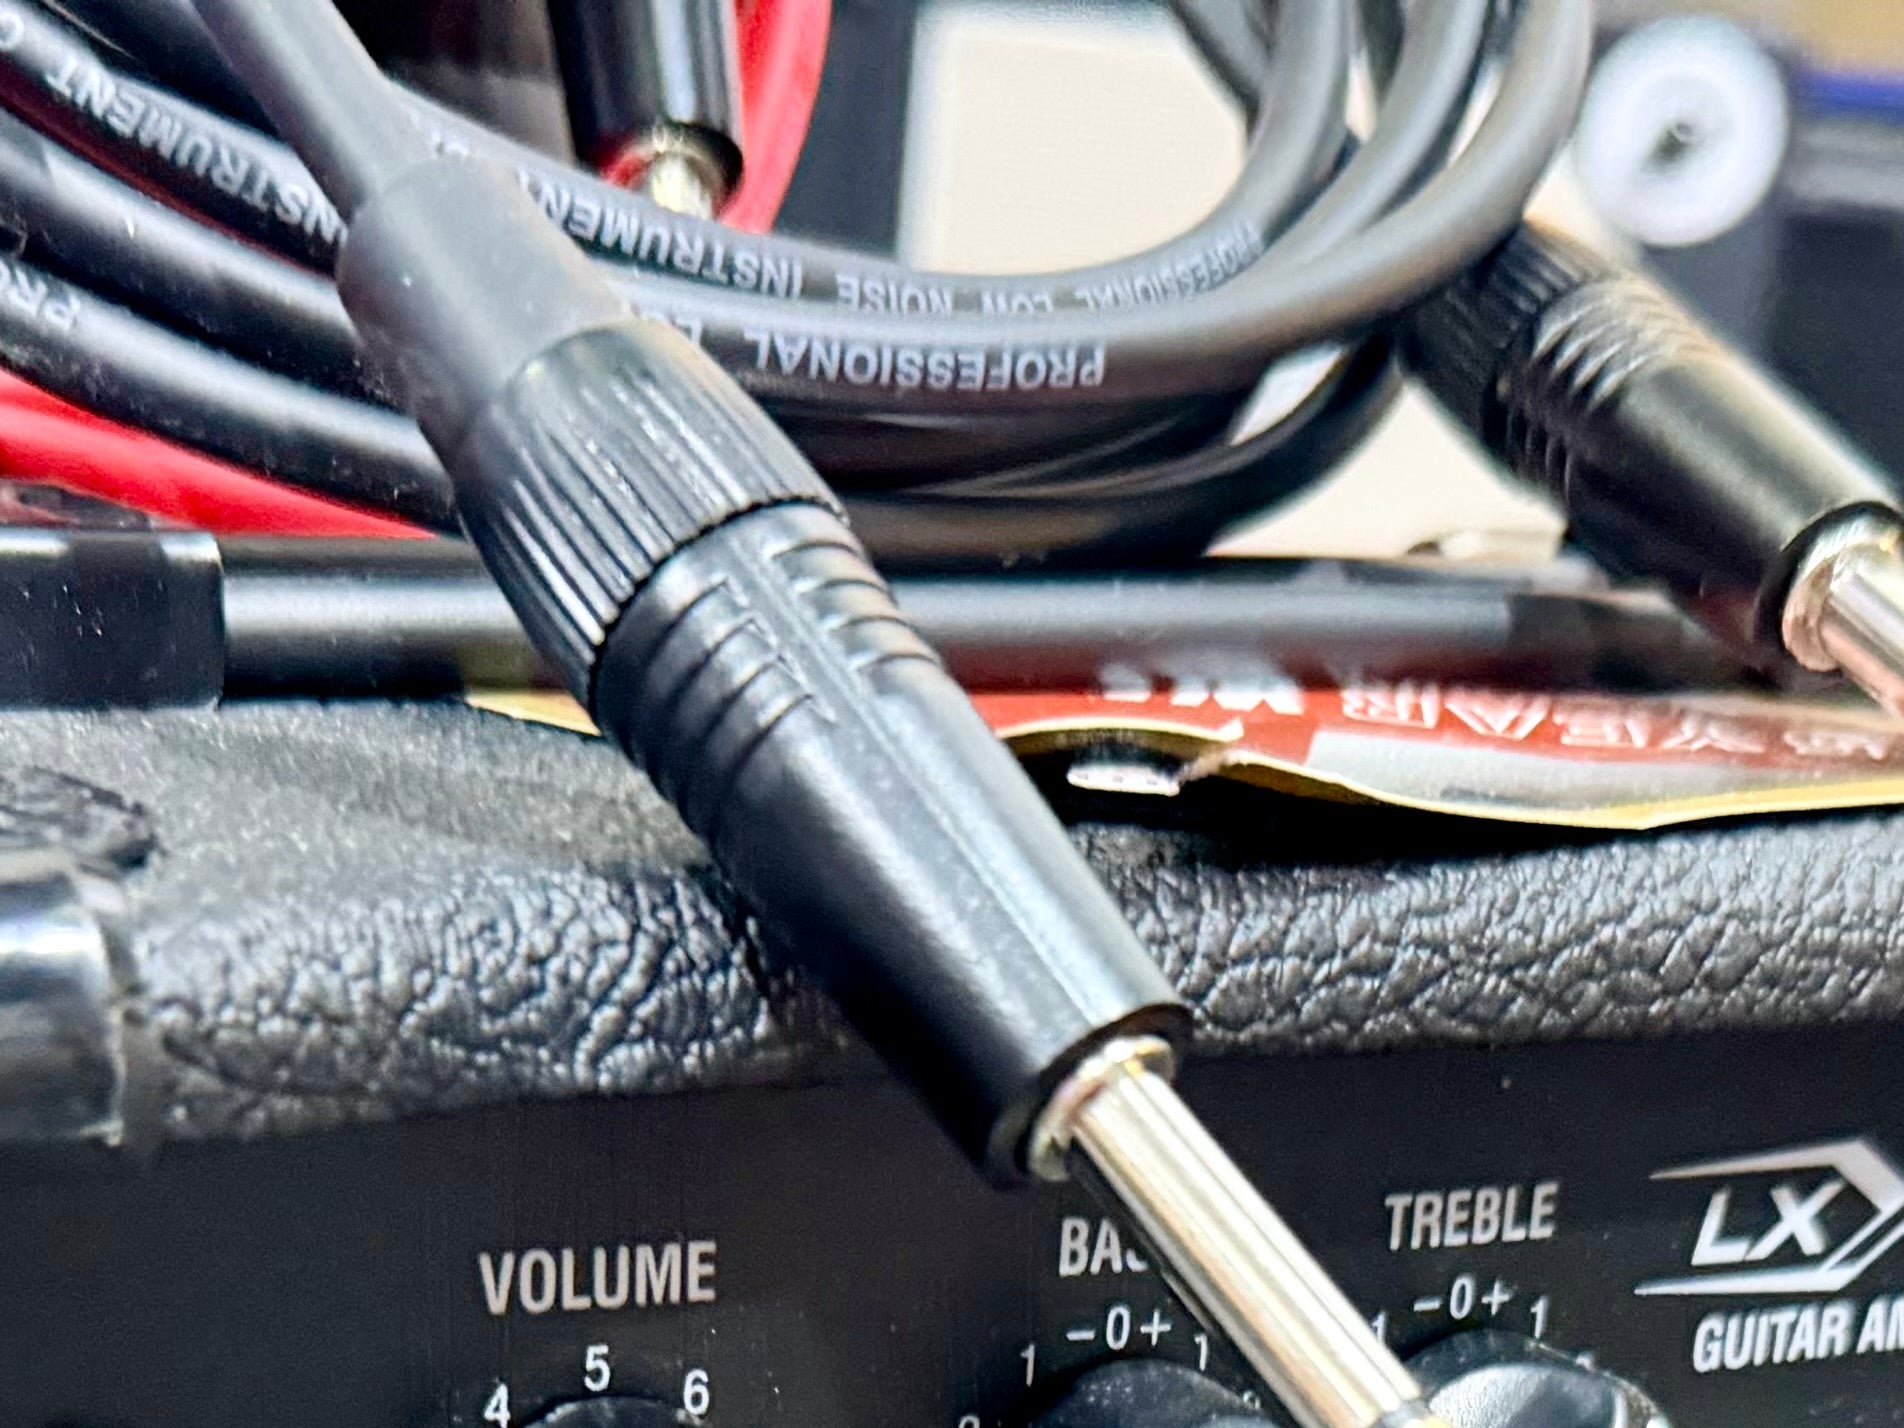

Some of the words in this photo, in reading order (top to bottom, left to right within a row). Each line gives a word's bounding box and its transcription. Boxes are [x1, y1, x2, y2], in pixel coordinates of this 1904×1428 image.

[741, 328, 1108, 390] PROFESSIONAL
[1057, 1208, 1154, 1278] BA
[1384, 1182, 1559, 1252] TREBLE
[478, 1240, 717, 1316] VOLUME
[1529, 1297, 1548, 1340] 1
[1693, 1309, 1853, 1374] GUITAR
[583, 1343, 612, 1393] 5
[1019, 1342, 1036, 1387] 1
[1190, 1333, 1209, 1378] 1
[682, 1368, 711, 1408] 6
